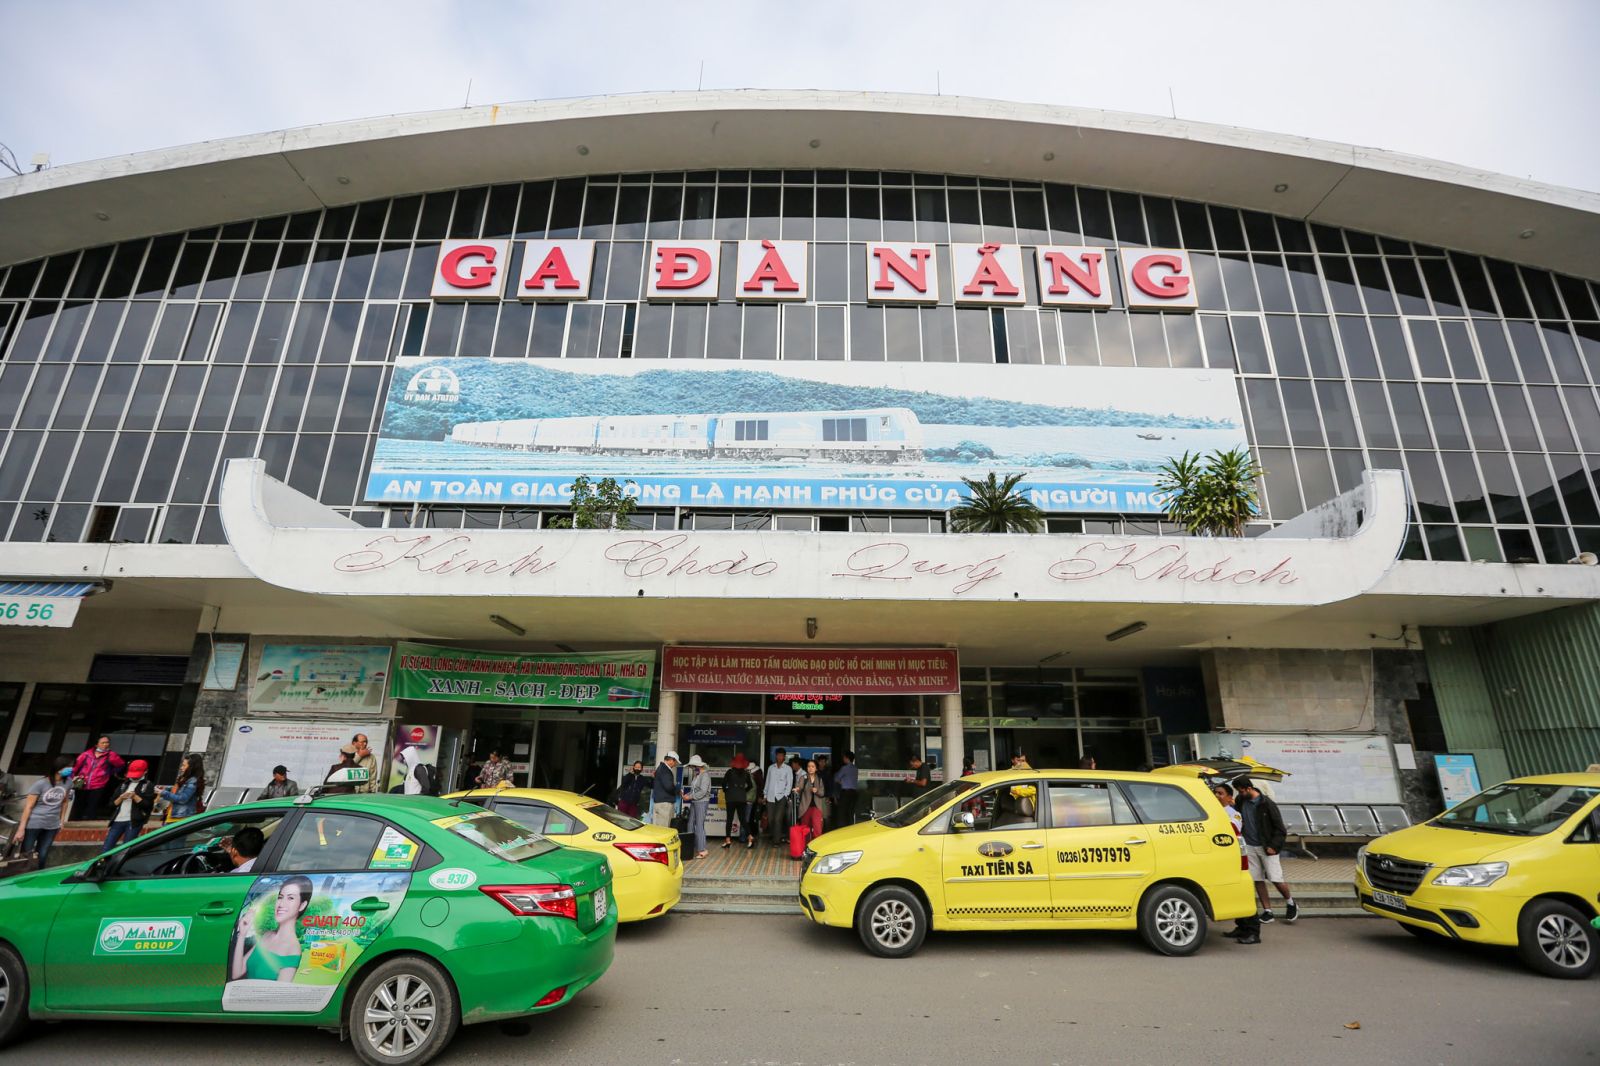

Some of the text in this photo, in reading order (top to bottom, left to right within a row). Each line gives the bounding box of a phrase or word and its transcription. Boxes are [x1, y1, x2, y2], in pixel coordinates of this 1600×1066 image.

[440, 239, 1191, 299] GA ĐÀ NẴNG
[383, 479, 422, 495] AN
[430, 478, 503, 496] TOÀN
[691, 481, 725, 499] LÀ
[733, 485, 812, 502] HẠNH
[820, 483, 897, 502] PHÚC
[904, 483, 962, 503] CỦA
[1030, 487, 1117, 506] NGƯỜI
[333, 534, 1300, 595] Kính Chào Quý Khách
[25, 603, 55, 620] 56
[672, 656, 690, 669] HỌC
[691, 654, 707, 669] TẬP
[708, 655, 720, 668] VÀ
[721, 655, 739, 669] LÀM
[740, 658, 761, 669] THEO
[763, 655, 780, 670] TẤM
[782, 658, 809, 670] GƯƠNG
[810, 658, 827, 672] ĐẠO
[828, 656, 846, 670] ĐỨC
[860, 656, 874, 670] CHÍ
[875, 659, 896, 670] MINH
[897, 656, 906, 670] VÌ
[907, 659, 926, 672] MỤC
[697, 671, 724, 685] GIÀU,
[726, 672, 753, 685] NƯỚC
[754, 674, 786, 687] MẠNH,
[788, 673, 809, 686] DÂN
[810, 672, 834, 687] CHỦ,
[836, 674, 863, 686] CÔNG
[896, 674, 917, 687] VĂN
[427, 677, 483, 695] XANH
[494, 680, 547, 701] SẠCH
[558, 683, 601, 703] ĐẸP
[1158, 822, 1205, 835] 43A.109.85
[960, 859, 1034, 877] TAXI TIÊN SA
[447, 873, 469, 885] 930
[302, 915, 367, 928] ENAT 400
[134, 941, 175, 950] GROUP
